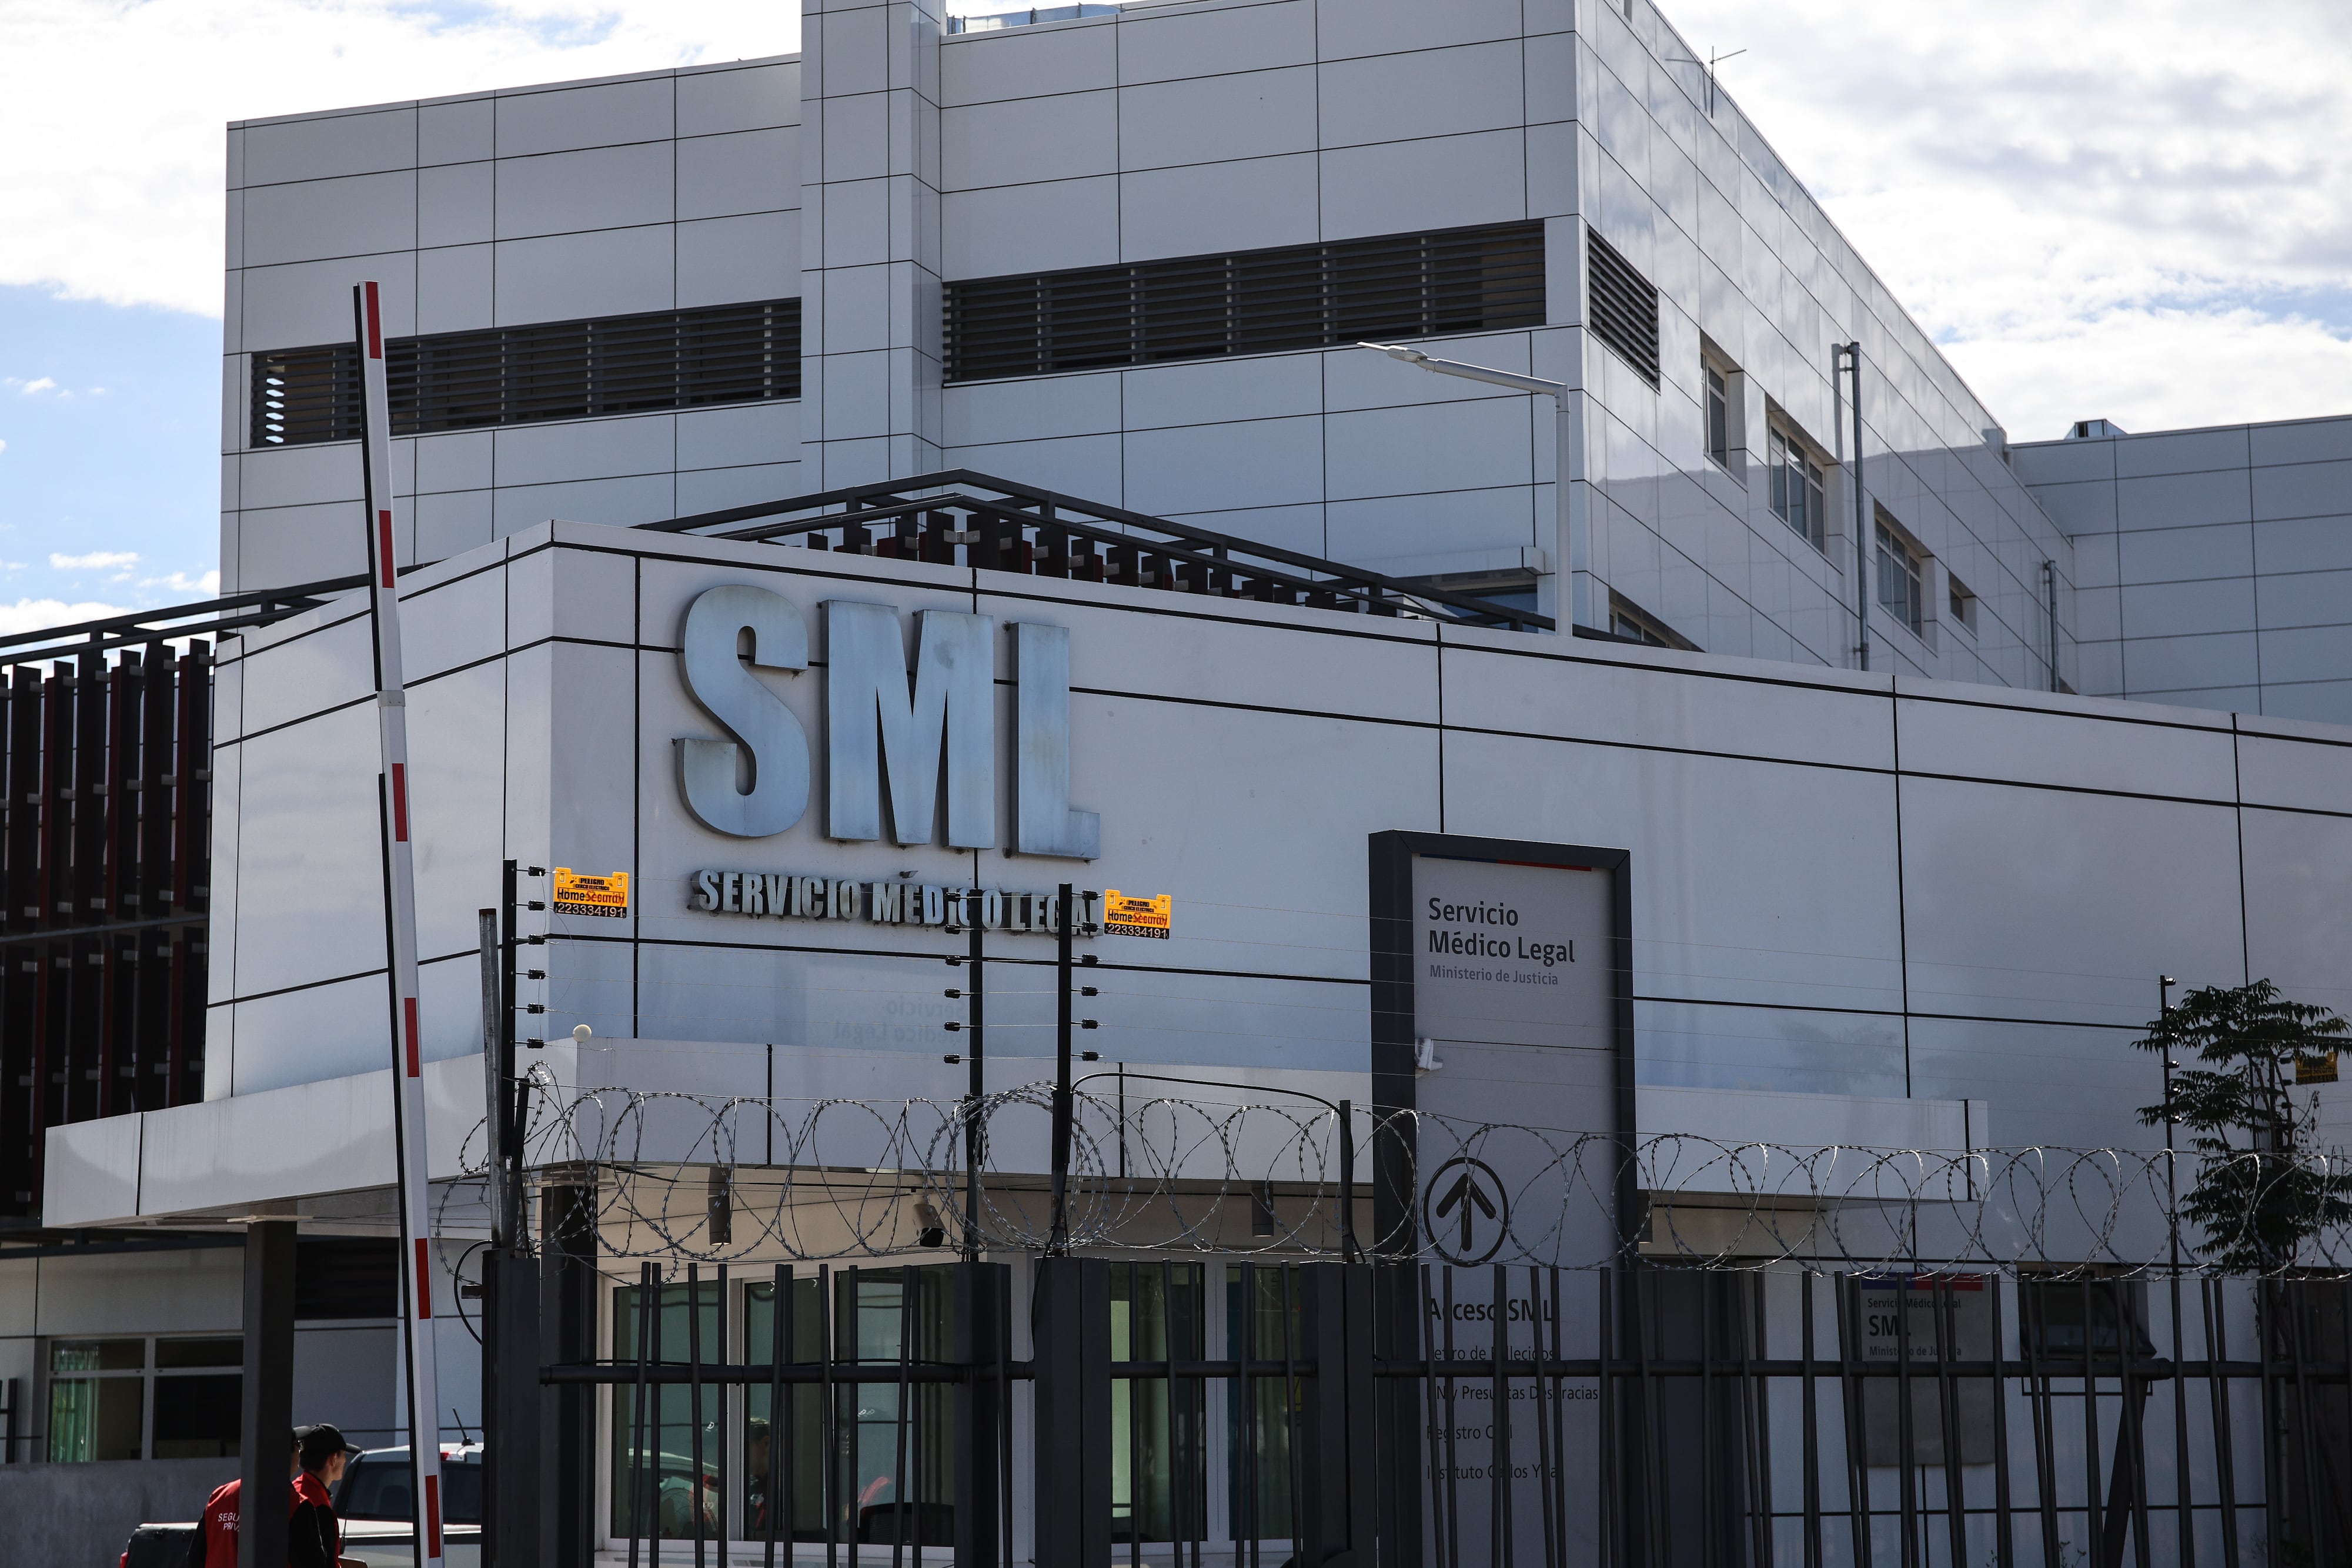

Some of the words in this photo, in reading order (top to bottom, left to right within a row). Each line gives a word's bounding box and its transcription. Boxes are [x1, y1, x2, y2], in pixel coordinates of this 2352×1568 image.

[676, 584, 1101, 861] SML
[693, 869, 861, 920] SERVICIO
[557, 903, 624, 917] 223334191
[1428, 897, 1518, 926] Servicio
[1108, 924, 1167, 938] 223334191
[1429, 930, 1511, 958] Médico
[1518, 937, 1575, 967] Legal
[1430, 965, 1492, 981] Ministerio
[1495, 969, 1510, 982] de
[1513, 971, 1558, 985] Justicia
[1429, 1298, 1495, 1321] Aceso
[1867, 1298, 1900, 1308] Servici
[1470, 1345, 1486, 1360] de
[1916, 1346, 1926, 1356] de
